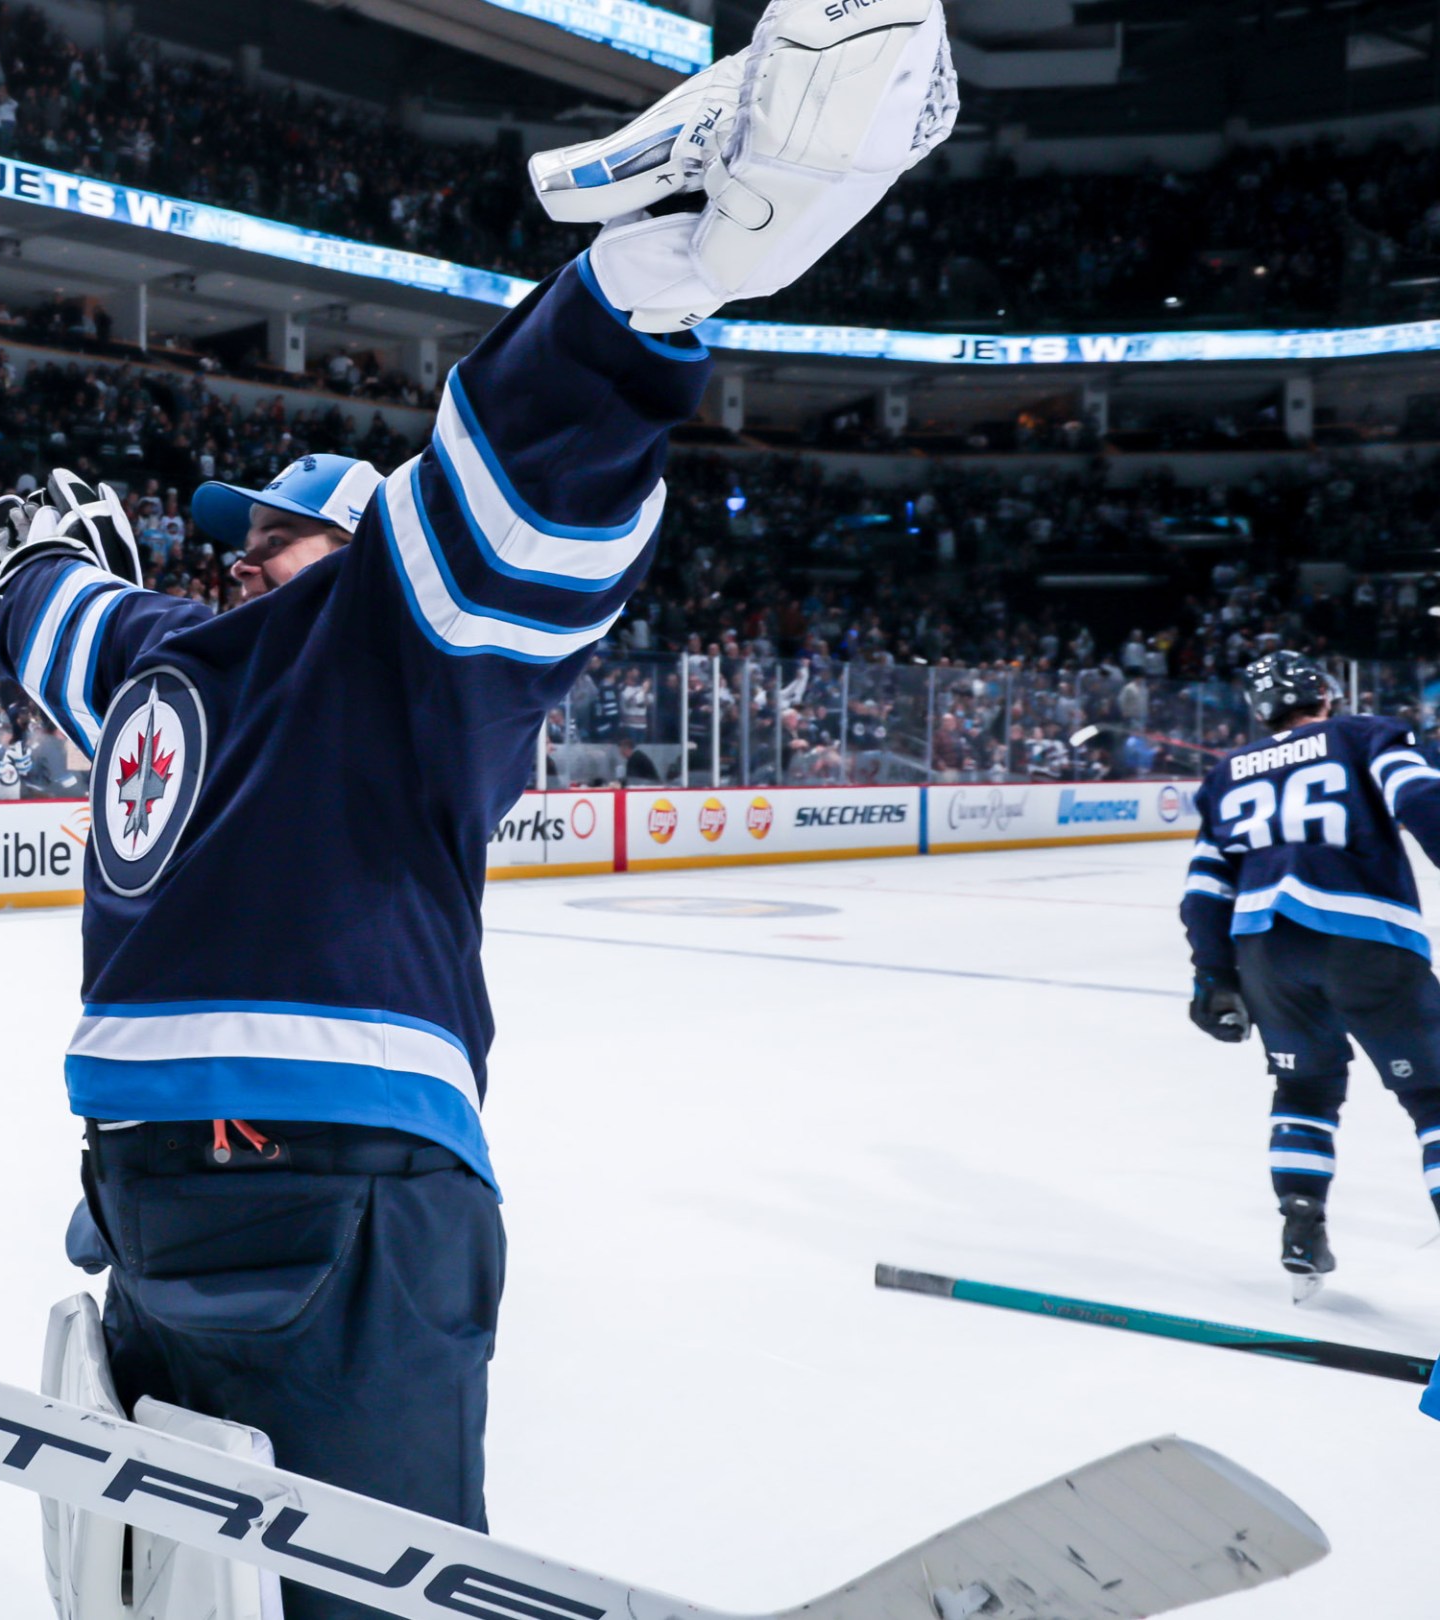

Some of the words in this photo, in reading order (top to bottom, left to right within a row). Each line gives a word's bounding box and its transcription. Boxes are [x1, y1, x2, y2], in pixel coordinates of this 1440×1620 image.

[689, 107, 722, 148] TRUE
[952, 337, 1067, 363] JETS
[1253, 675, 1274, 692] 36
[1230, 733, 1327, 781] BARRON
[794, 804, 908, 828] SKECHERS
[1220, 761, 1347, 849] 36
